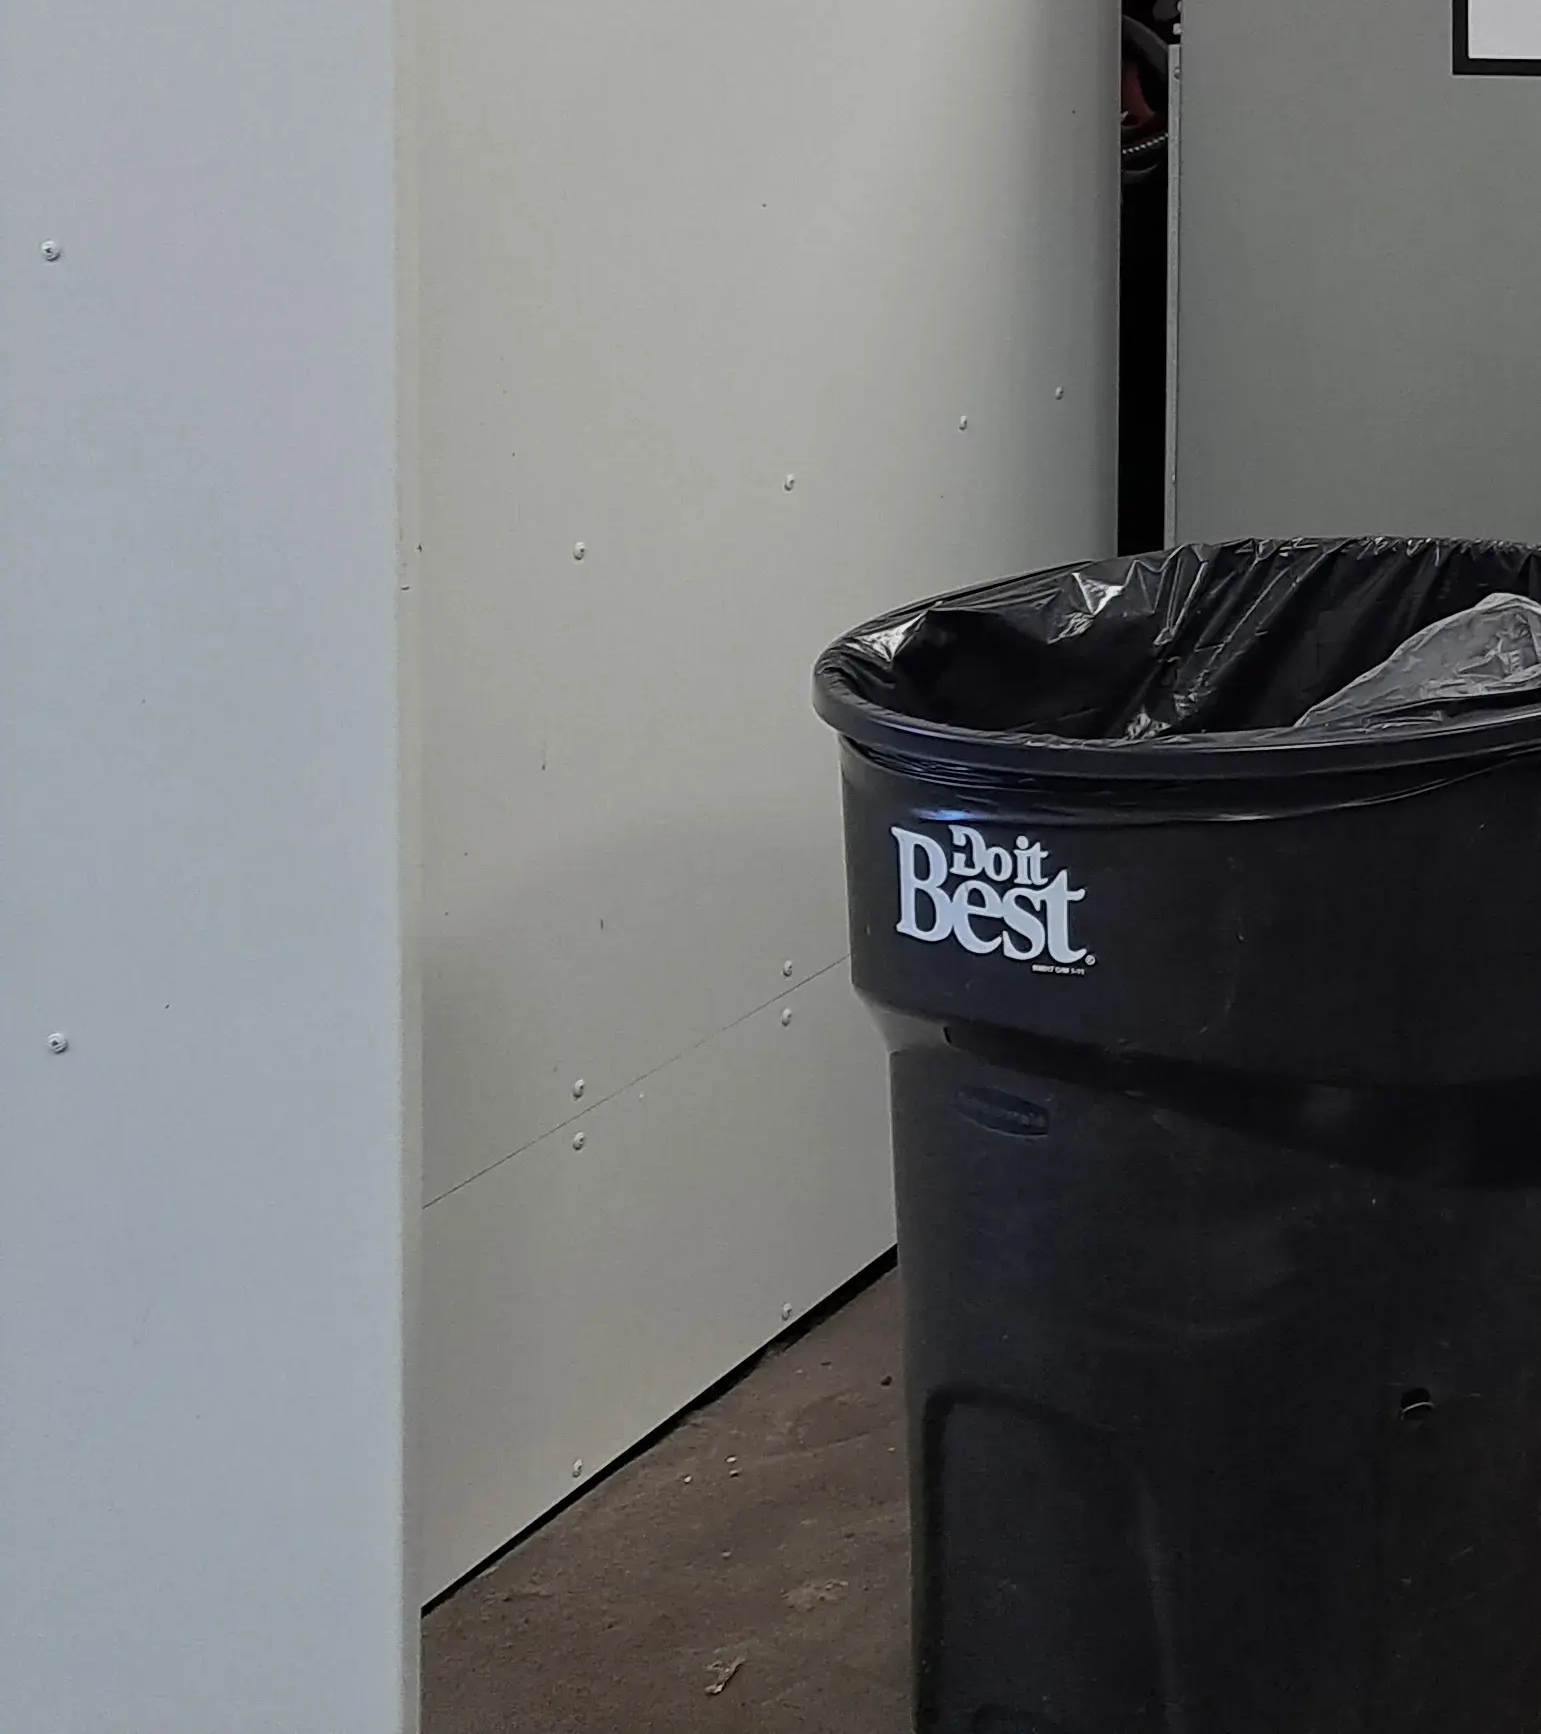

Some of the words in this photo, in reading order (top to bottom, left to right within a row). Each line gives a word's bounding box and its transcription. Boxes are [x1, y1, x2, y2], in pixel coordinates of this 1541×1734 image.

[891, 826, 1087, 965] Best
[948, 825, 1013, 882] Do
[1012, 835, 1050, 885] it
